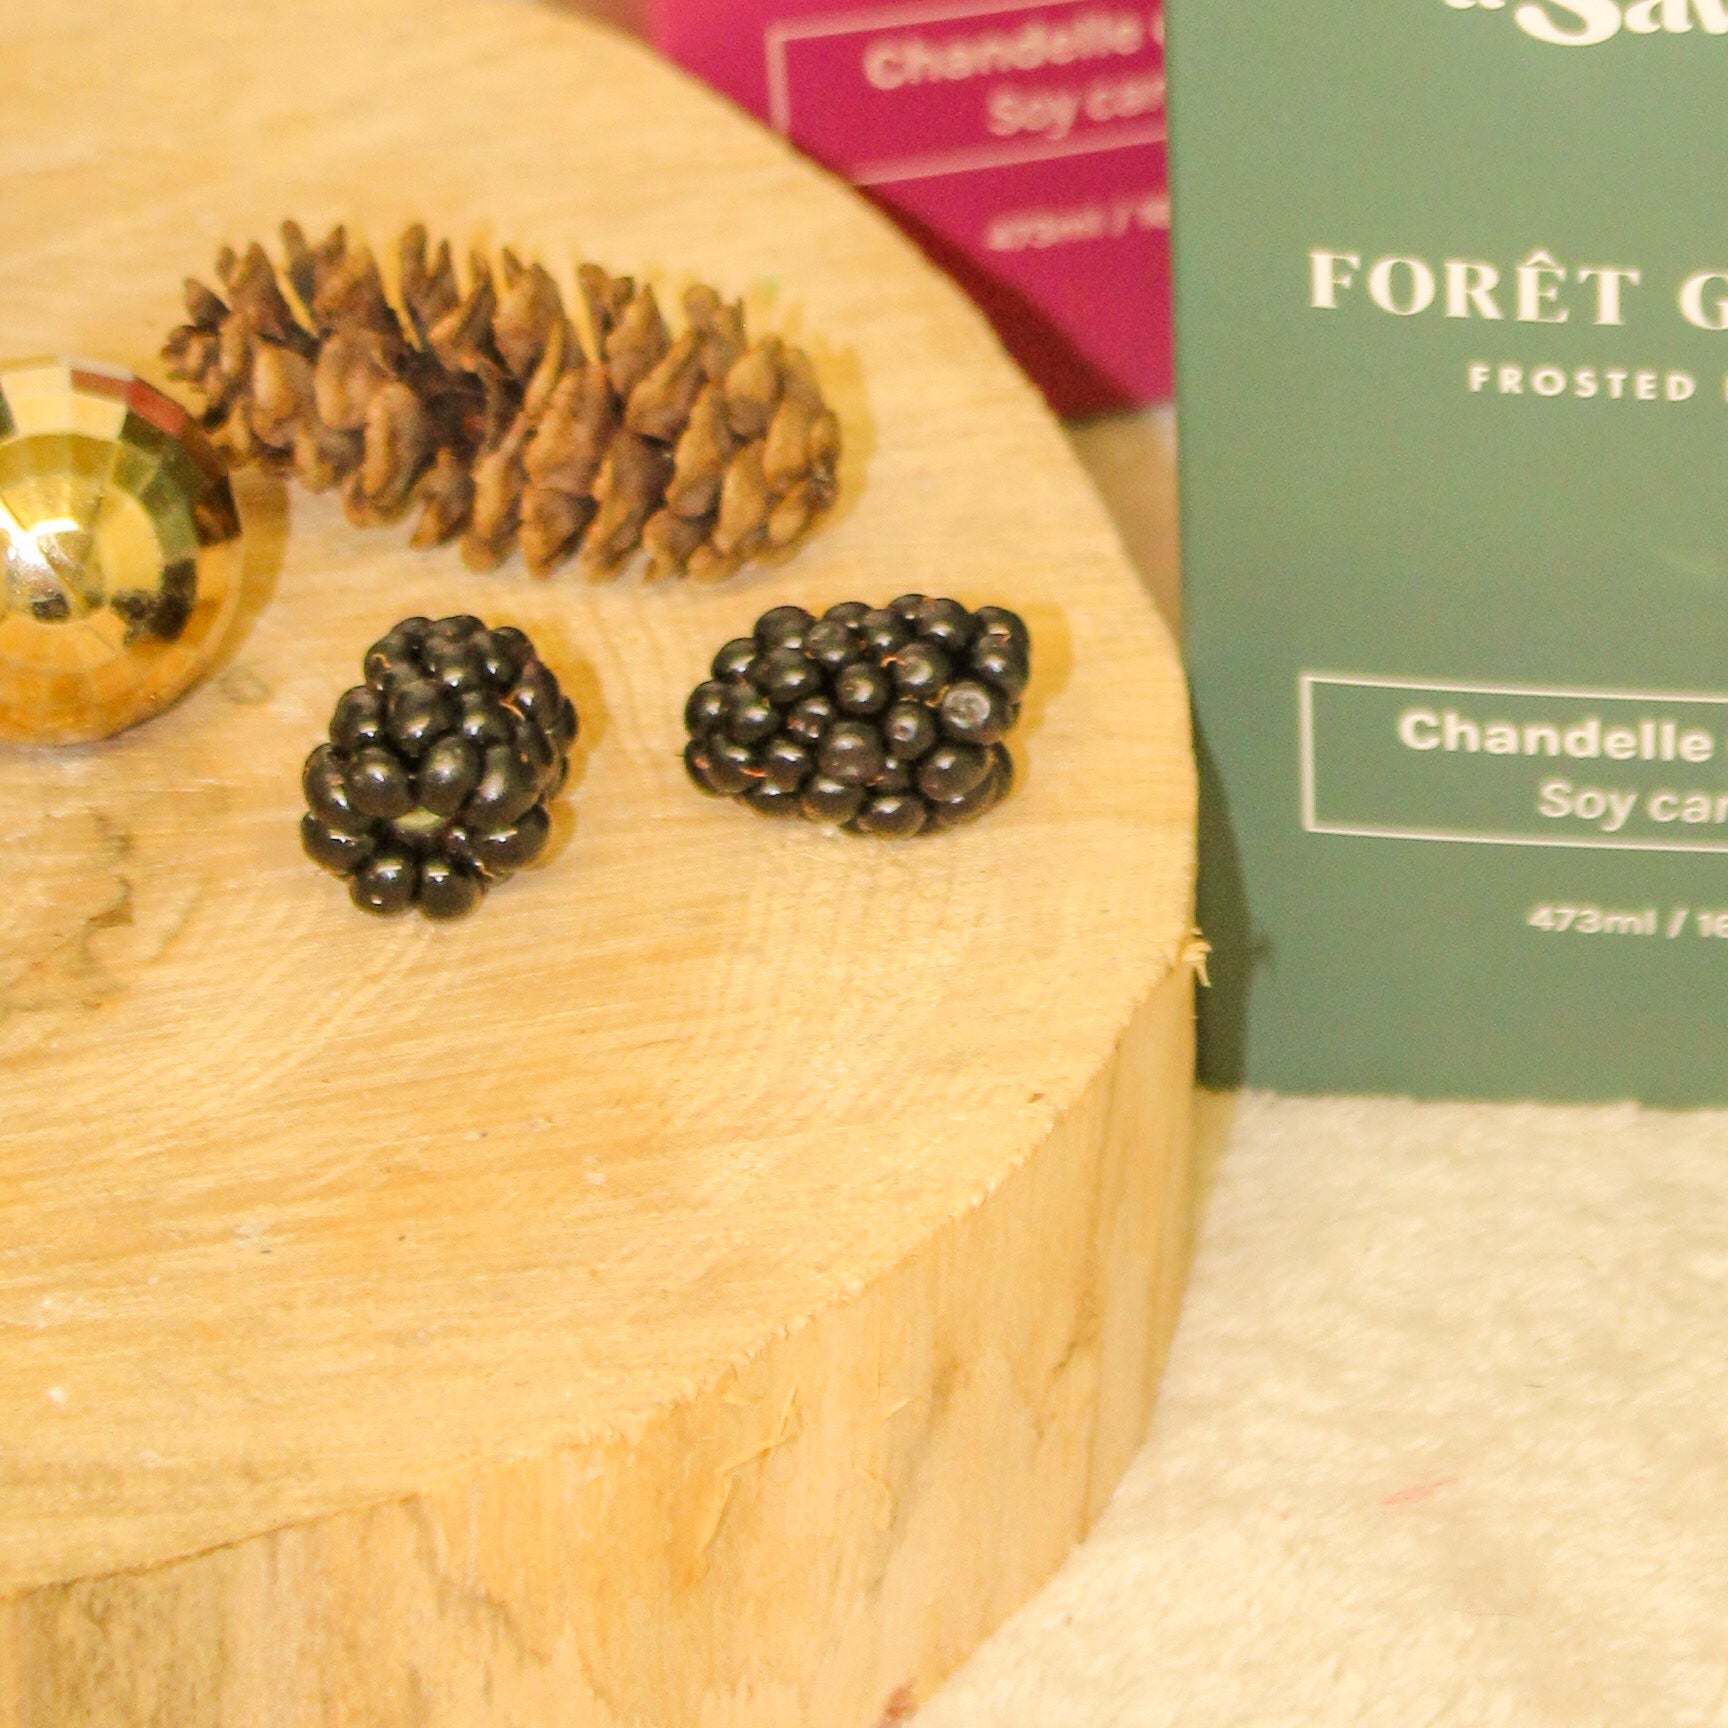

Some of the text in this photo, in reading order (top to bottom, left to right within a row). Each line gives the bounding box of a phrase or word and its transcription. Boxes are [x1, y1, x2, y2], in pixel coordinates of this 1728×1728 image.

[864, 14, 1145, 90] Chandelle
[988, 87, 1076, 140] Soy
[1309, 250, 1641, 326] FORÊT
[1469, 363, 1697, 402] FROSTED
[1400, 709, 1713, 764] Chandelle
[1540, 780, 1635, 833] Soy
[1528, 905, 1655, 937] 473ml
